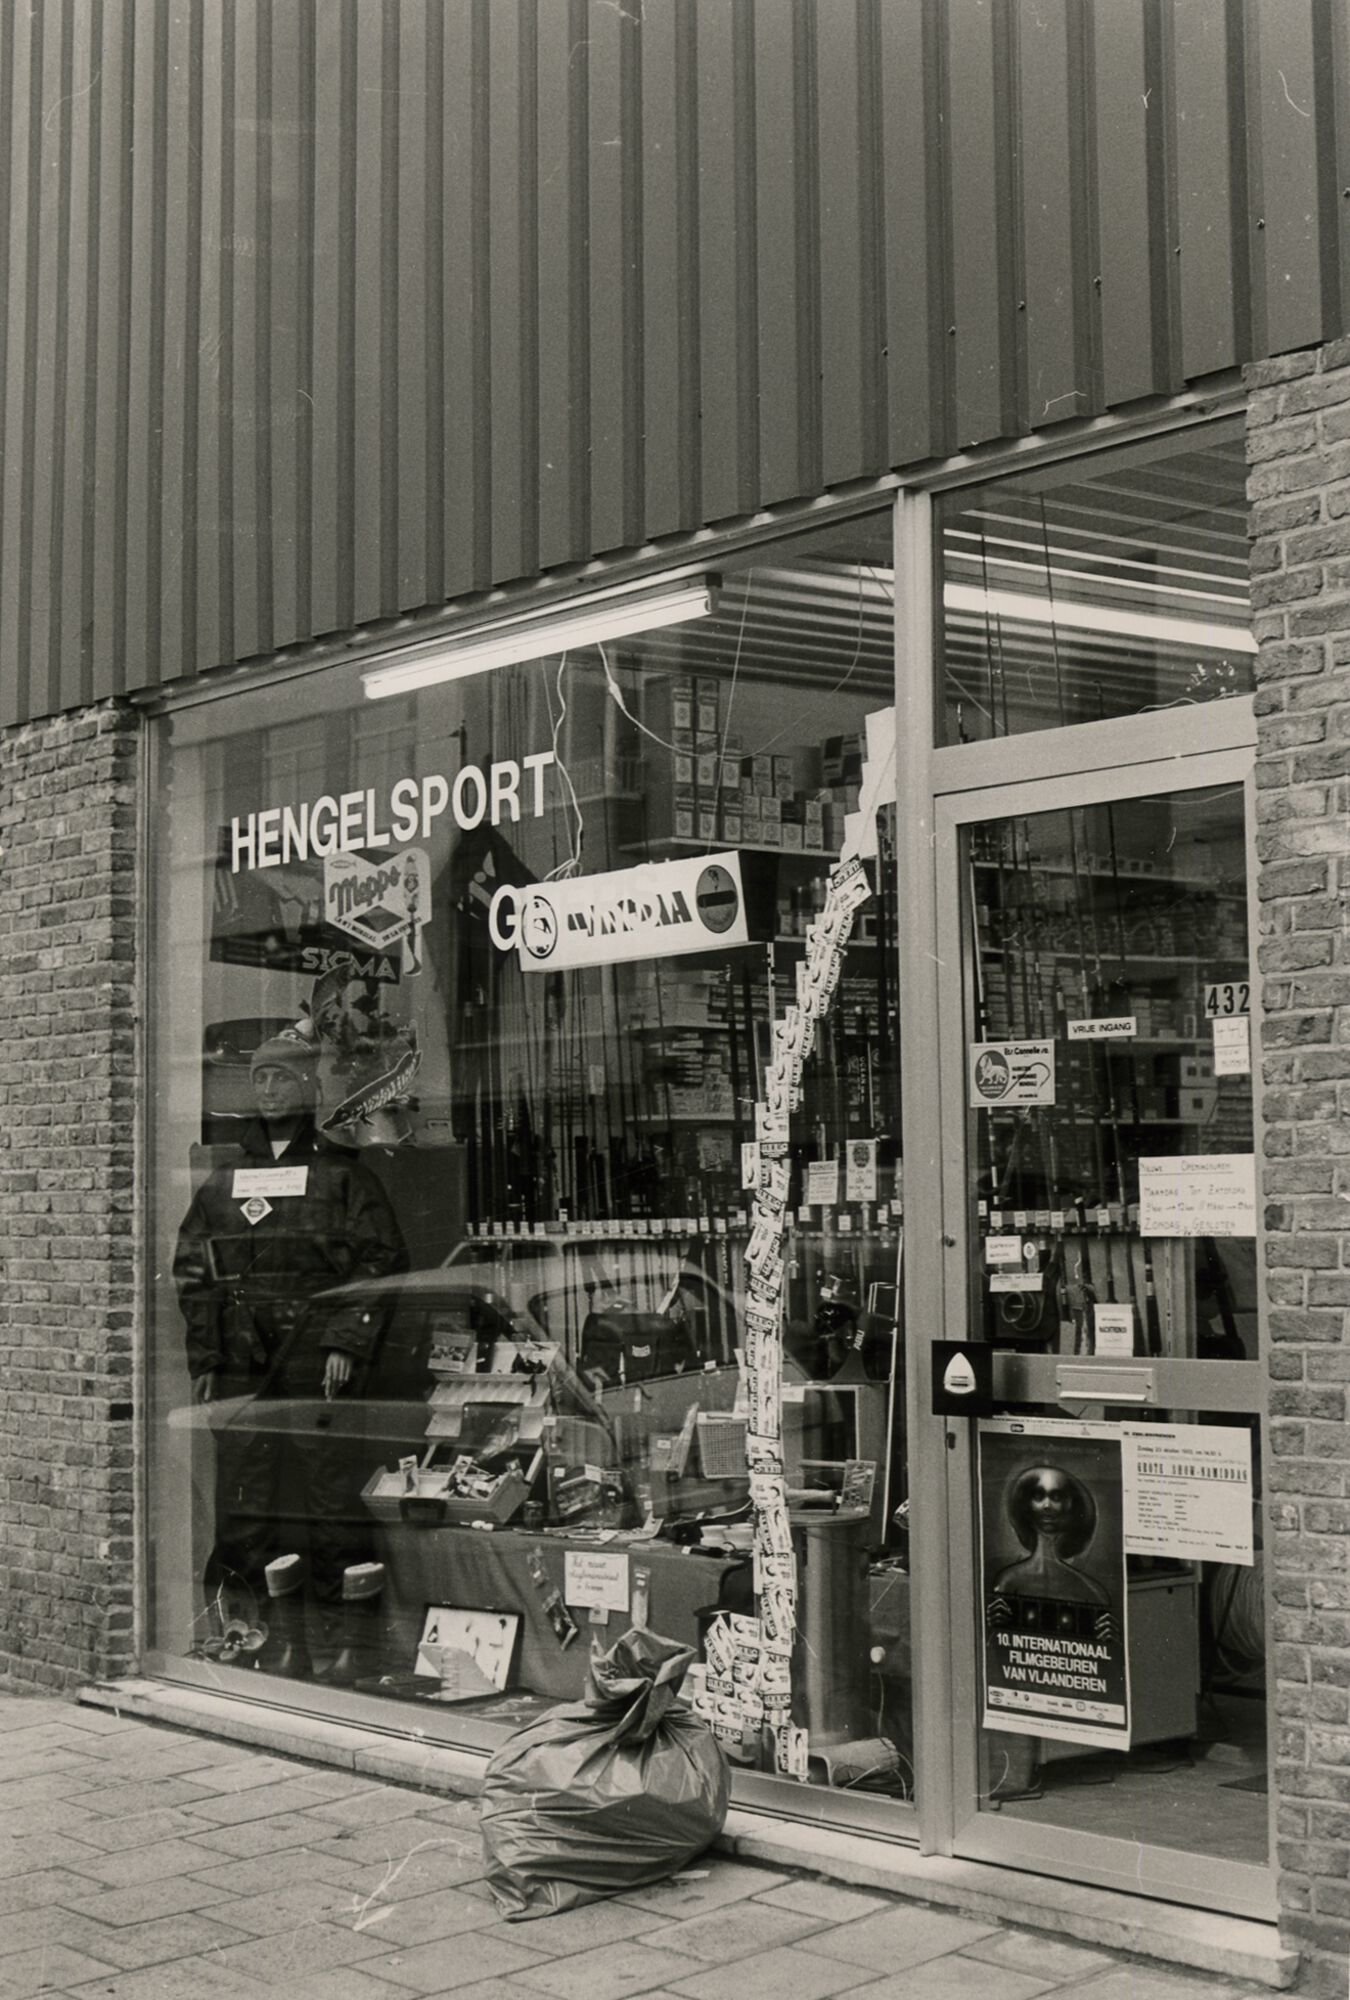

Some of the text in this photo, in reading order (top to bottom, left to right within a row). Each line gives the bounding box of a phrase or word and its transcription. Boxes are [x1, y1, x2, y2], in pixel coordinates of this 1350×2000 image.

[231, 751, 555, 874] HENGELSPORT
[329, 865, 401, 918] Mepps
[301, 946, 396, 980] SIGMA
[1207, 983, 1250, 1015] 432
[1072, 1022, 1132, 1034] VRIJE INGANG
[1137, 1462, 1164, 1475] GROTE
[996, 1632, 1112, 1660] 10. INTERNATIONAAL
[1009, 1650, 1099, 1675] FILMGEBEUREN
[1002, 1665, 1107, 1693] VAN VLAANDEREN
